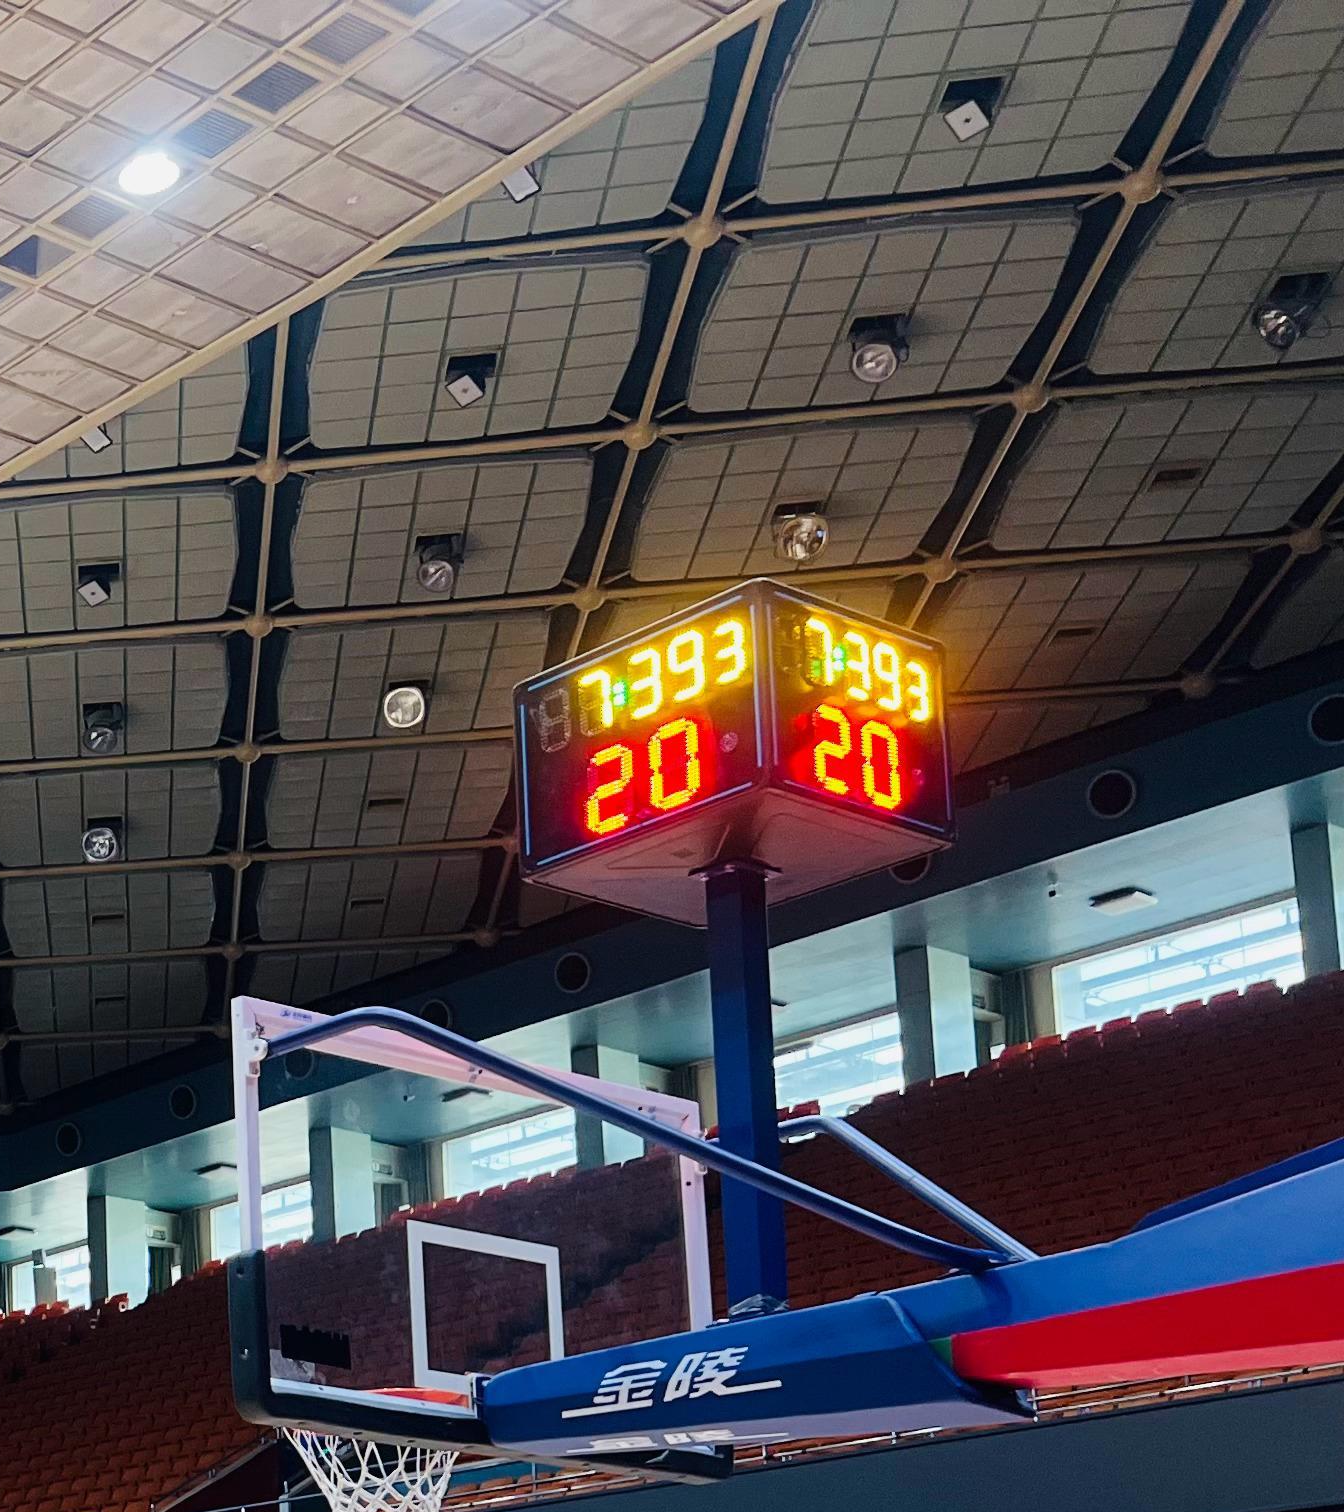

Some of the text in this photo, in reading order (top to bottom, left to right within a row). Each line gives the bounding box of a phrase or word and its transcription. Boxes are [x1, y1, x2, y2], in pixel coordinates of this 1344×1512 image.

[586, 718, 699, 835] 20
[814, 703, 902, 810] 20
[562, 1346, 782, 1418] 金陵
